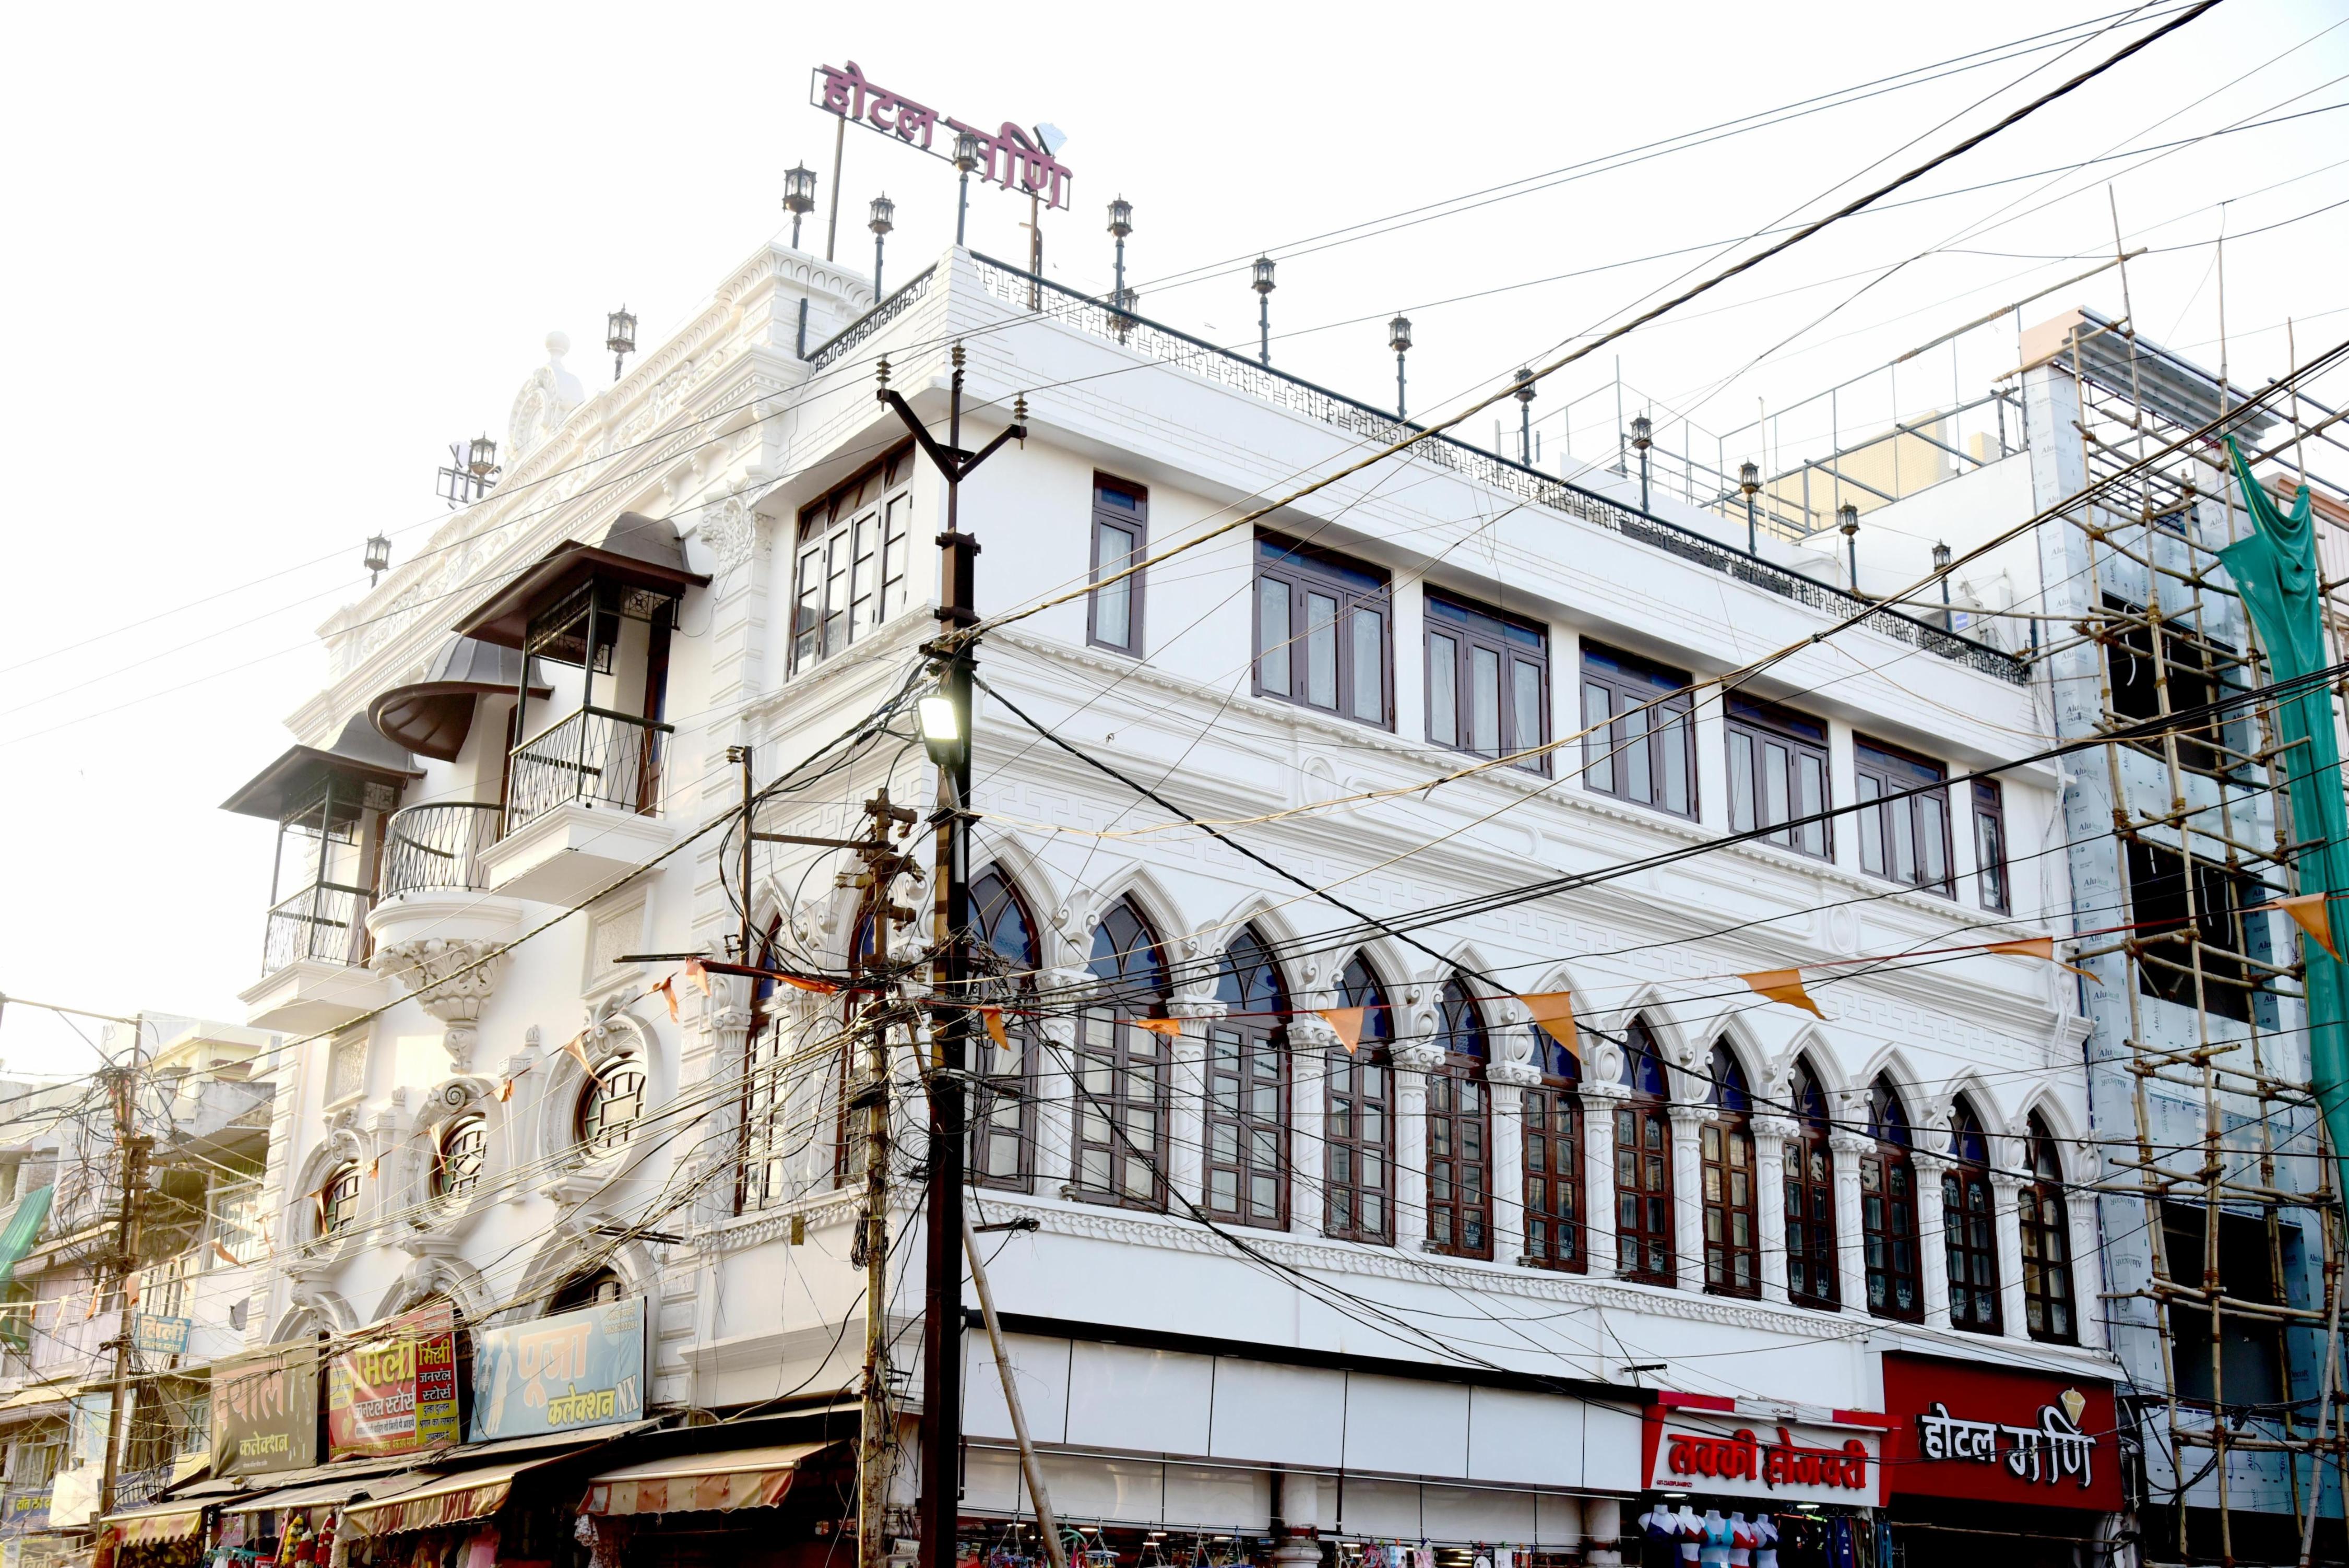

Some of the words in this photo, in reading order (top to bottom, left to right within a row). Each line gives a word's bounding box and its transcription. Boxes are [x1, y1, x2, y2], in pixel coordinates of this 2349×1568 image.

[820, 60, 939, 150] होटल
[418, 1338, 451, 1366] मिली
[518, 1321, 592, 1408] पूजा
[548, 1382, 616, 1428] कलेक्शन
[616, 1373, 639, 1418] NX
[239, 1431, 289, 1456] कलेक्शन
[1667, 1429, 1758, 1480] लक्की
[1917, 1402, 1997, 1462] होटल
[2002, 1405, 2096, 1487] मणि
